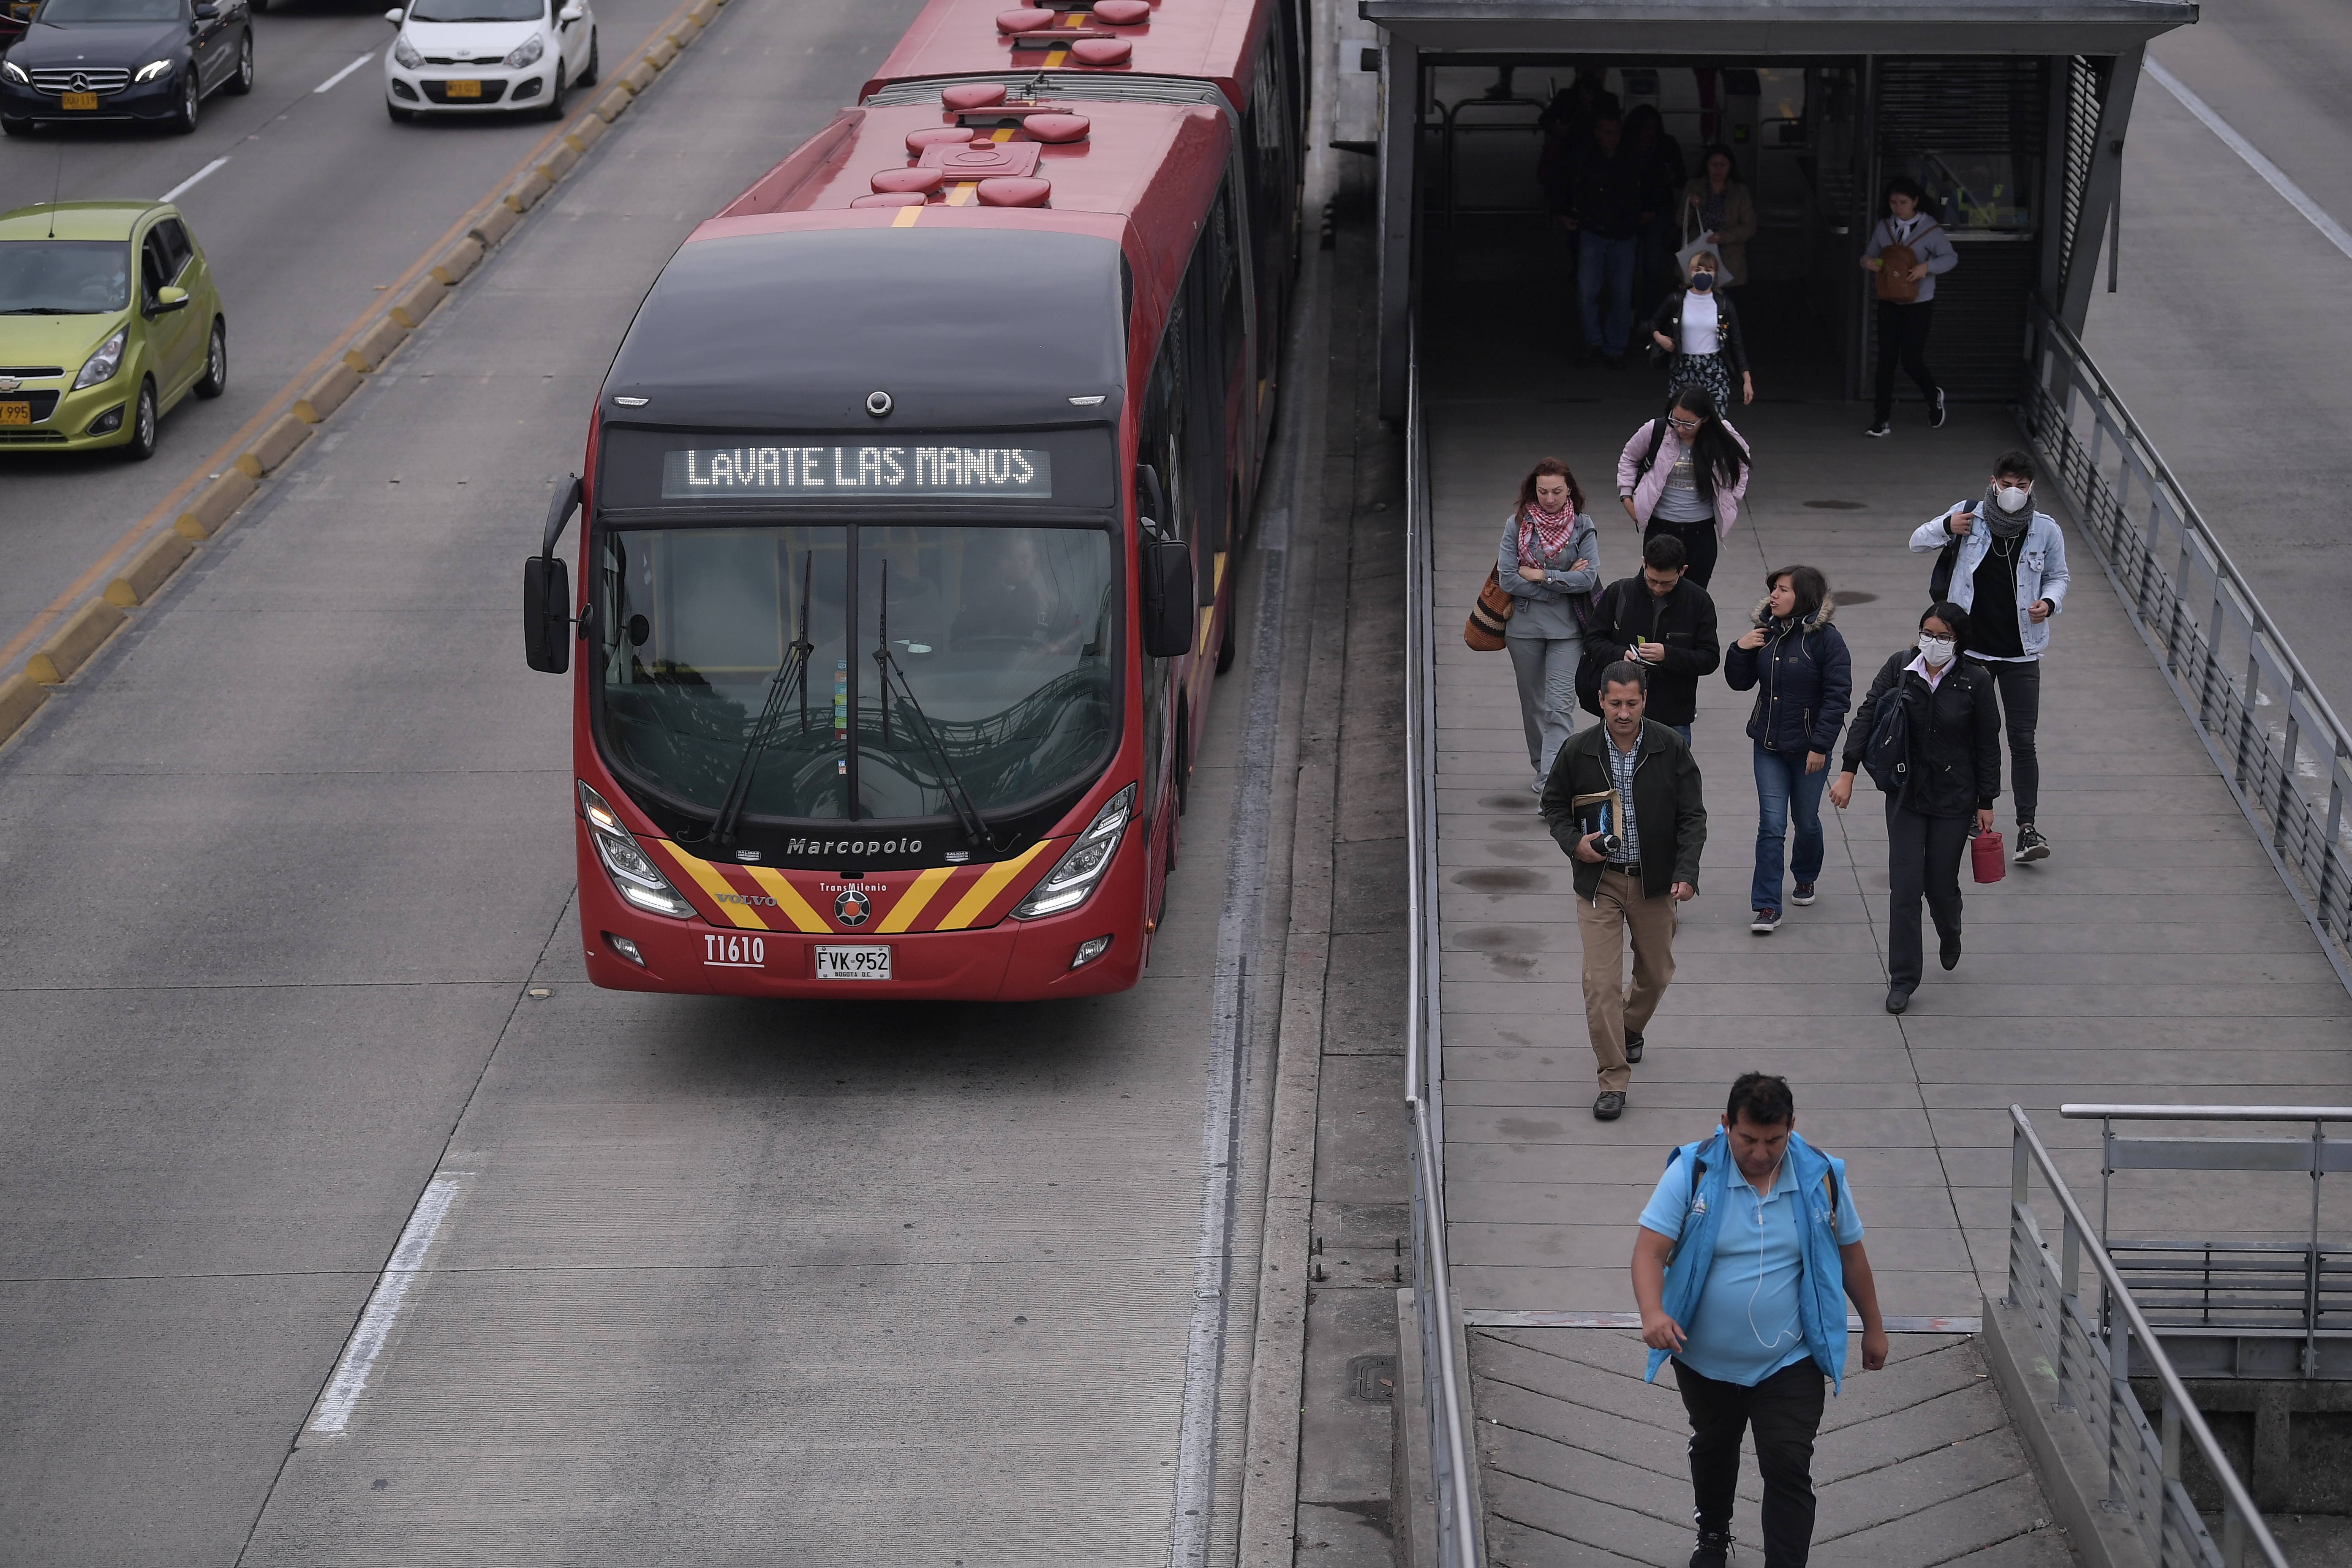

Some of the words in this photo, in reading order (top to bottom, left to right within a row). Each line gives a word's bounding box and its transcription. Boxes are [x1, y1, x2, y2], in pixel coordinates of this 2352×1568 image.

[7, 407, 28, 418] 995
[835, 448, 905, 485] LAS
[787, 838, 922, 856] Marcopolo
[820, 882, 887, 891] TransMilenio
[715, 893, 777, 906] VOLVO
[705, 934, 764, 963] T1610
